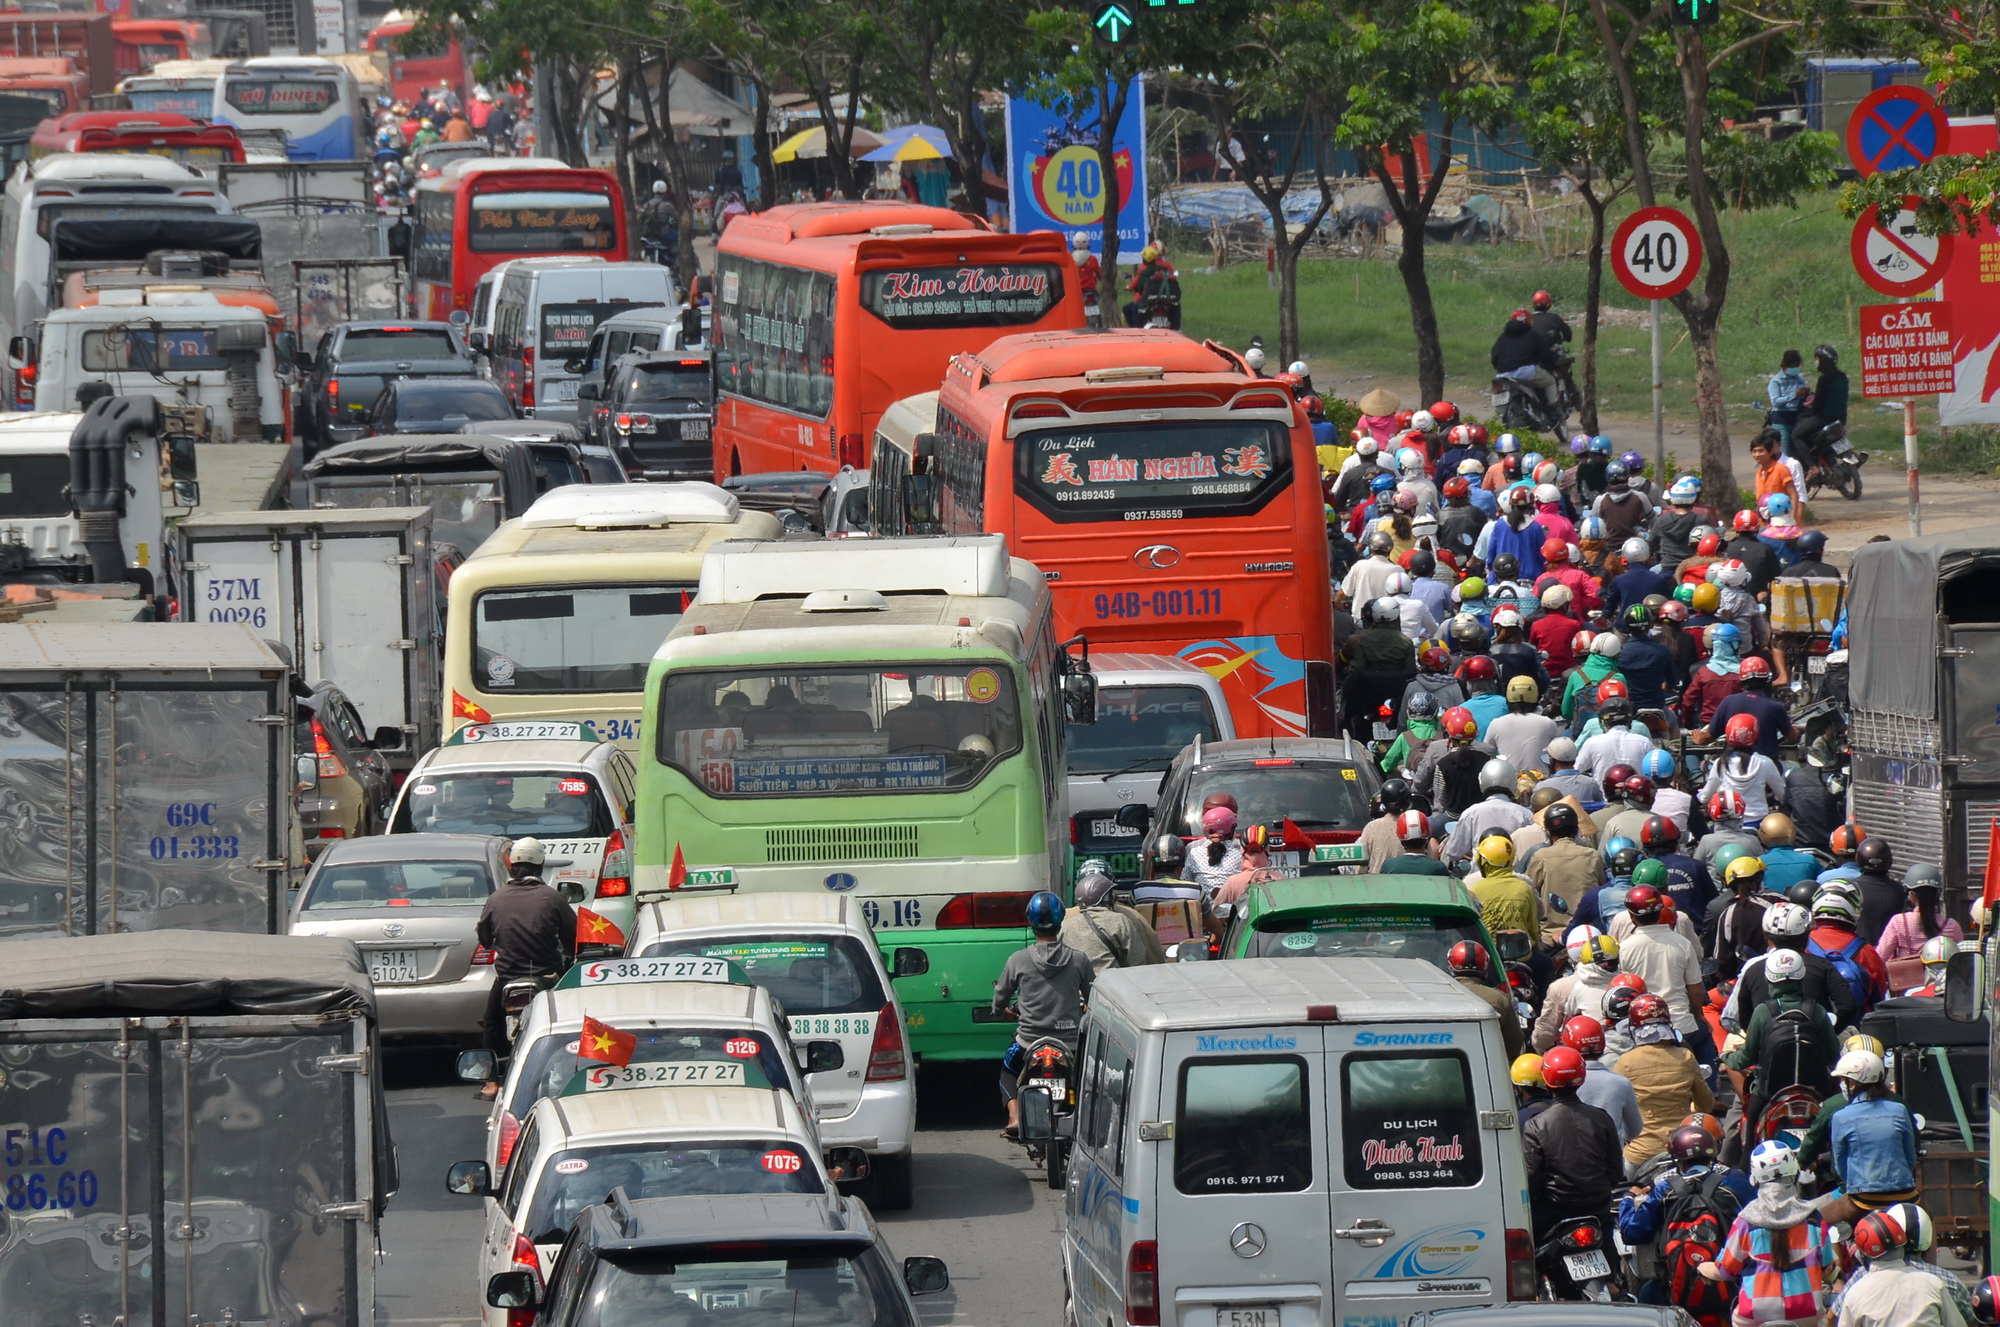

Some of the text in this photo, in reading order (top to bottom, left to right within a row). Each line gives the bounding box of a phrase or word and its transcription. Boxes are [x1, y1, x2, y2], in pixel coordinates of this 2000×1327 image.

[1056, 159, 1100, 199] 40
[1065, 199, 1094, 214] NĂM
[560, 208, 600, 229] Long
[1632, 232, 1677, 273] 40
[882, 267, 1048, 299] Kim Hoàng
[1881, 306, 1932, 330] CẤM
[1866, 327, 1949, 350] CÁC LOẠI XE 3 BÁNH
[1864, 352, 1875, 369] VÀ
[1877, 355, 1888, 369] XE
[1890, 350, 1907, 368] THÔ
[1922, 353, 1927, 366] 4
[1929, 348, 1952, 366] BÁNH
[1038, 436, 1096, 452] Du Lịch
[1088, 452, 1219, 482] HÁN NGHĨA
[1222, 445, 1272, 480] 漢
[1056, 490, 1115, 502] 0913.892435
[1192, 483, 1251, 495] 0948.668884
[1124, 509, 1183, 521] 0937.558559
[1244, 562, 1294, 573] HYUNDAI
[208, 578, 261, 601] 57M
[1094, 588, 1221, 620] 94B-001.11
[209, 607, 266, 628] 0026
[492, 726, 577, 738] 38.27 27 27
[700, 763, 734, 793] 150
[739, 778, 763, 792] SUỐI
[819, 780, 825, 790] 3
[561, 781, 586, 792] 7585
[167, 802, 217, 827] 69C
[150, 835, 239, 860] 01.333
[561, 842, 600, 855] 27 27
[1287, 934, 1314, 946] 8252
[382, 952, 406, 966] 51A
[373, 967, 415, 981] 510.74
[617, 962, 724, 977] 38.27 27 27
[794, 1019, 870, 1035] 38 38 38 38
[726, 1041, 757, 1053] 6126
[1196, 1034, 1297, 1051] Mercedes
[1353, 1032, 1454, 1046] SPRINTER
[622, 1065, 738, 1081] 38.27 27 27
[1383, 1119, 1438, 1130] DU LỊCH
[5, 1128, 68, 1167] 51C
[1362, 1134, 1463, 1170] Phước Hạnh
[560, 1162, 584, 1171] SATRA
[765, 1154, 800, 1170] 7075
[1207, 1175, 1284, 1186] 0916. 971 971
[1374, 1170, 1454, 1181] 0988. 533 464
[0, 1169, 98, 1211] 86.60
[1572, 1262, 1607, 1279] 209.63
[1231, 1311, 1265, 1327] 53N
